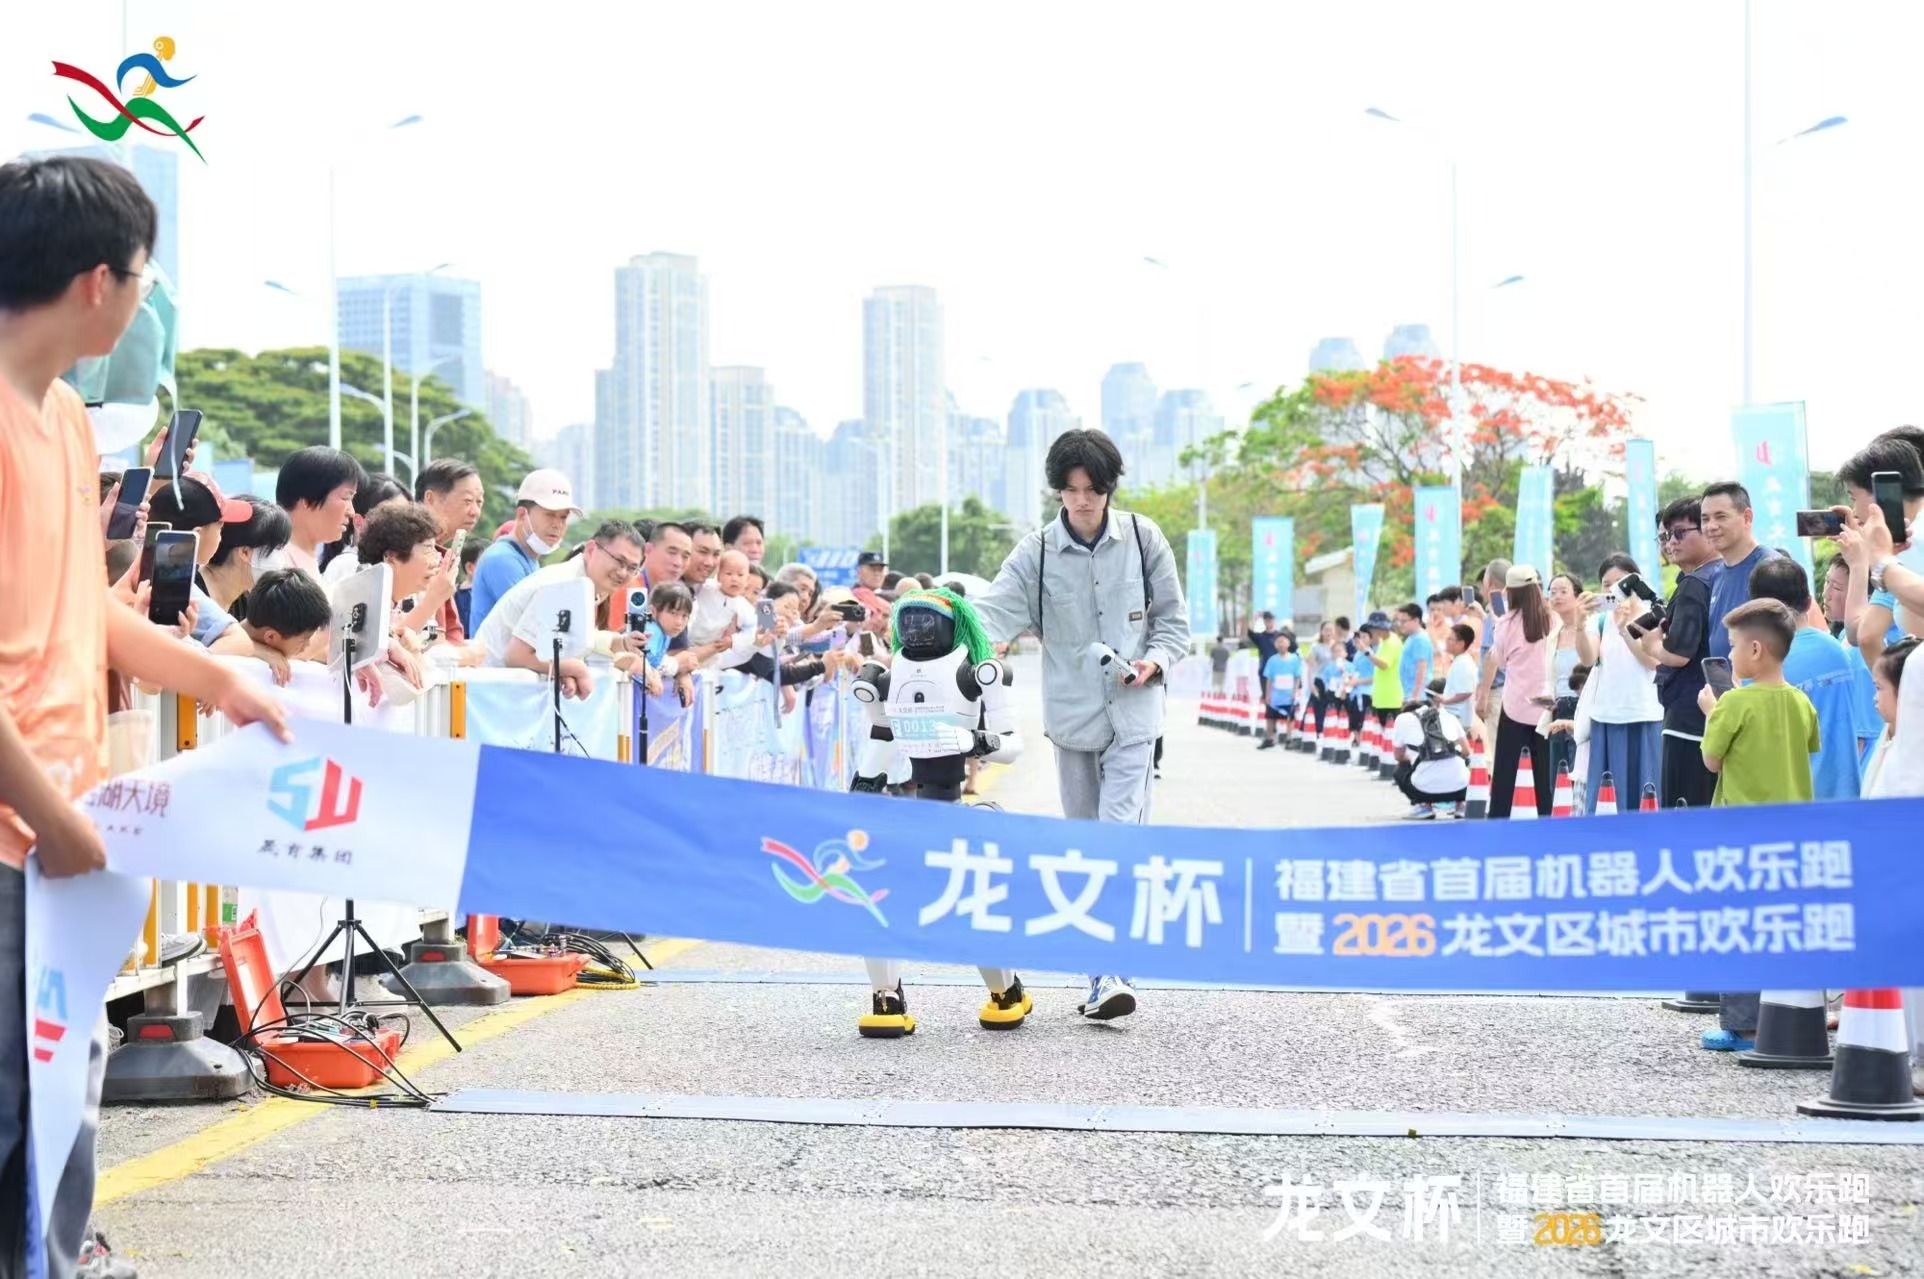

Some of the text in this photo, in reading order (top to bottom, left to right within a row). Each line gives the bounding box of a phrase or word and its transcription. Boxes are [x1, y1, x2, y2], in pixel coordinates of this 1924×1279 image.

[918, 838, 1224, 949] 龙文杯
[1274, 840, 1854, 902] 福建省首届机器人欢乐跑
